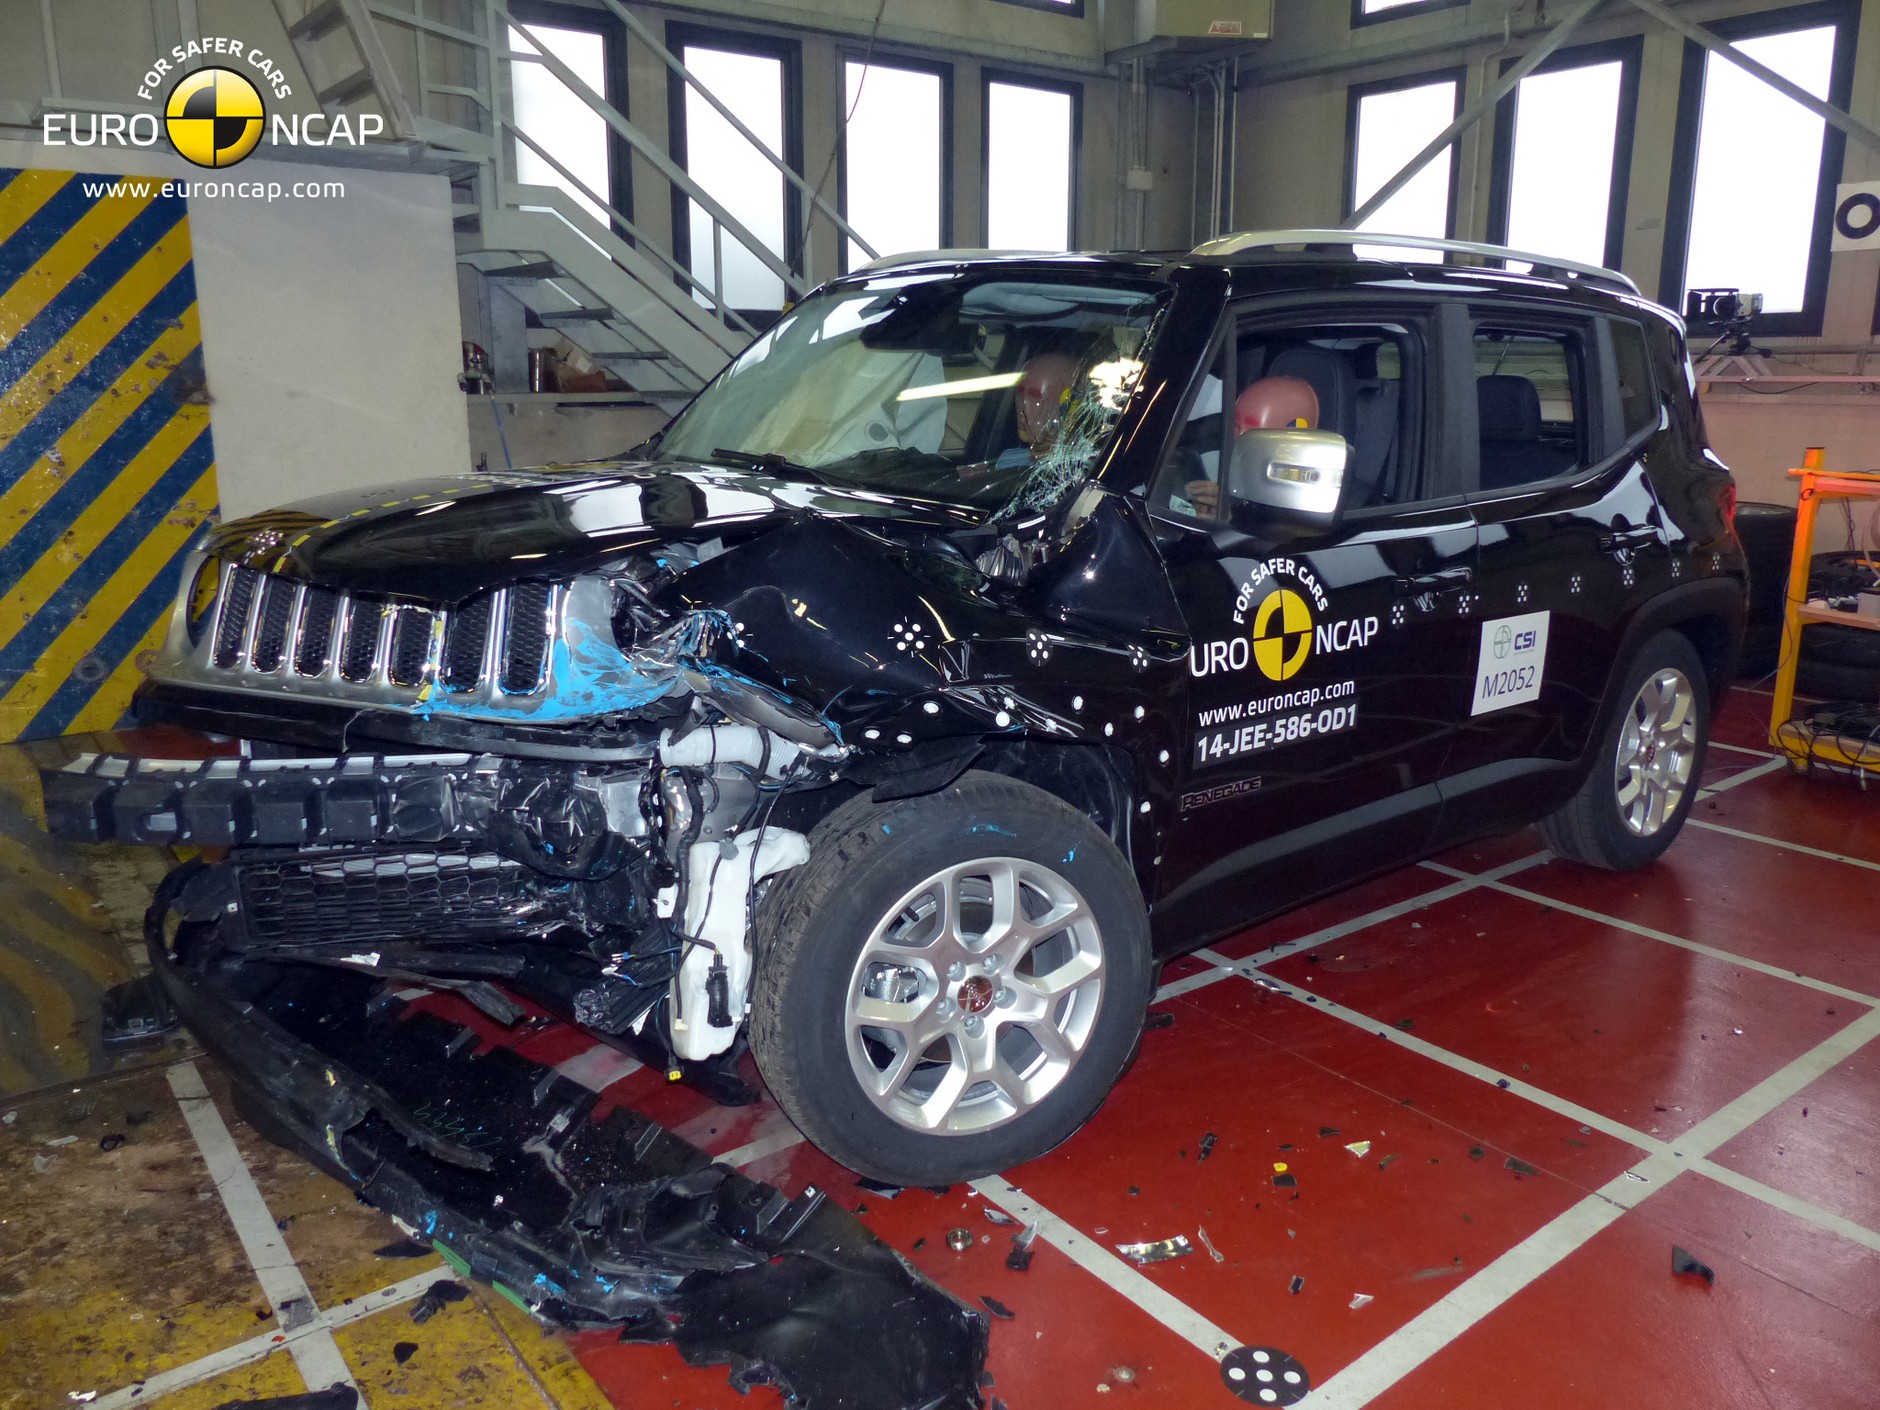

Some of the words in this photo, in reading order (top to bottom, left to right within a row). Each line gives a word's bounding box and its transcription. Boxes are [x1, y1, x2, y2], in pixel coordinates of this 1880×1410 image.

[1233, 582, 1254, 625] FOR
[1250, 558, 1295, 586] SAFER
[1298, 566, 1329, 612] CARS
[1190, 637, 1249, 678] URO
[1315, 616, 1379, 655] NCAP
[1514, 630, 1536, 650] CSI
[1482, 665, 1535, 699] M2052
[1198, 680, 1355, 727] www.euroncap.com
[1180, 776, 1261, 812] RENEGADE
